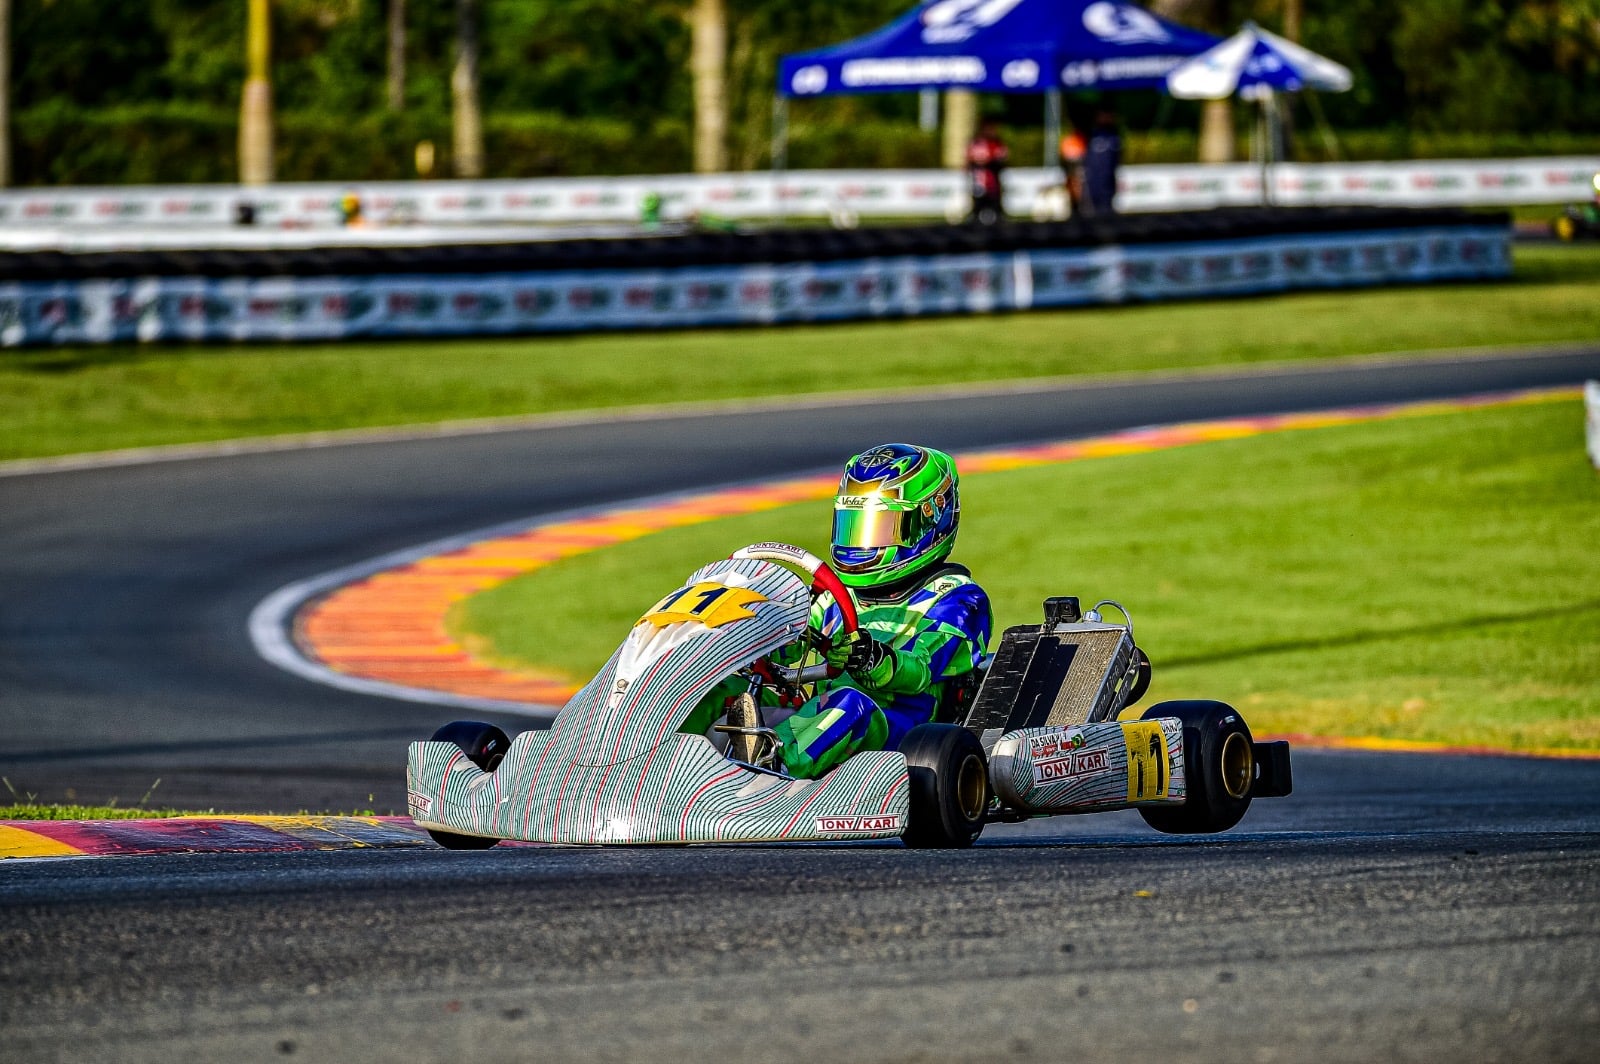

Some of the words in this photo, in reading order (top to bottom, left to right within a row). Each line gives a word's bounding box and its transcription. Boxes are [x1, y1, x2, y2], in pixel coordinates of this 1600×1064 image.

[657, 585, 729, 615] 11
[1036, 758, 1071, 779] TONY
[1076, 750, 1106, 772] KART
[818, 817, 854, 830] TONY
[863, 816, 898, 829] KART
